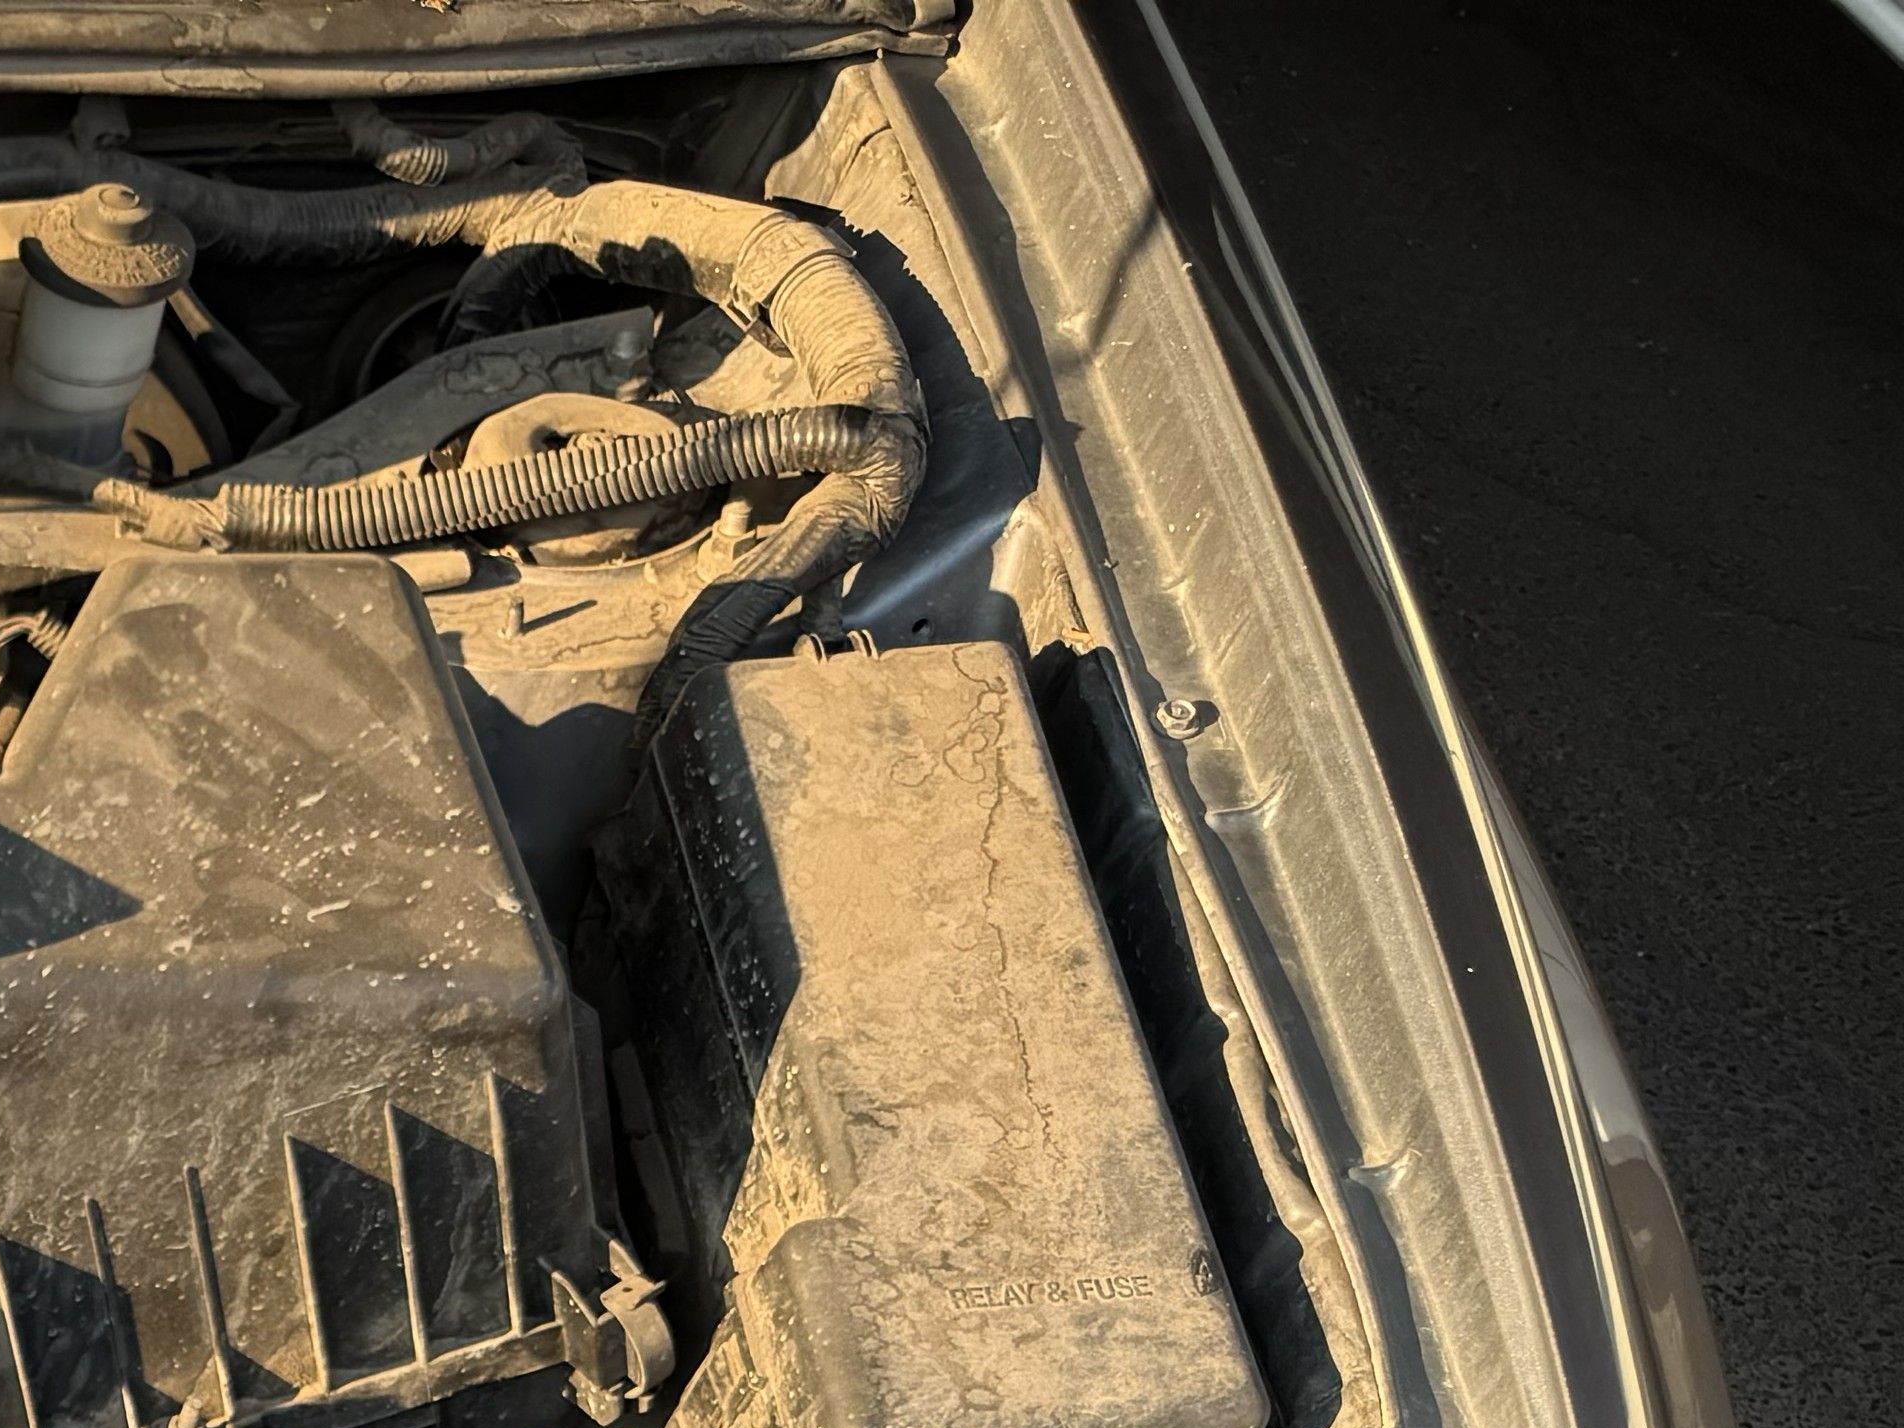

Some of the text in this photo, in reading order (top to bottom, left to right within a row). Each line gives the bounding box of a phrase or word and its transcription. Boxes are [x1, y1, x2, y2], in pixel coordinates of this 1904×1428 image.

[947, 1275, 1153, 1310] RELAY & FUSE
